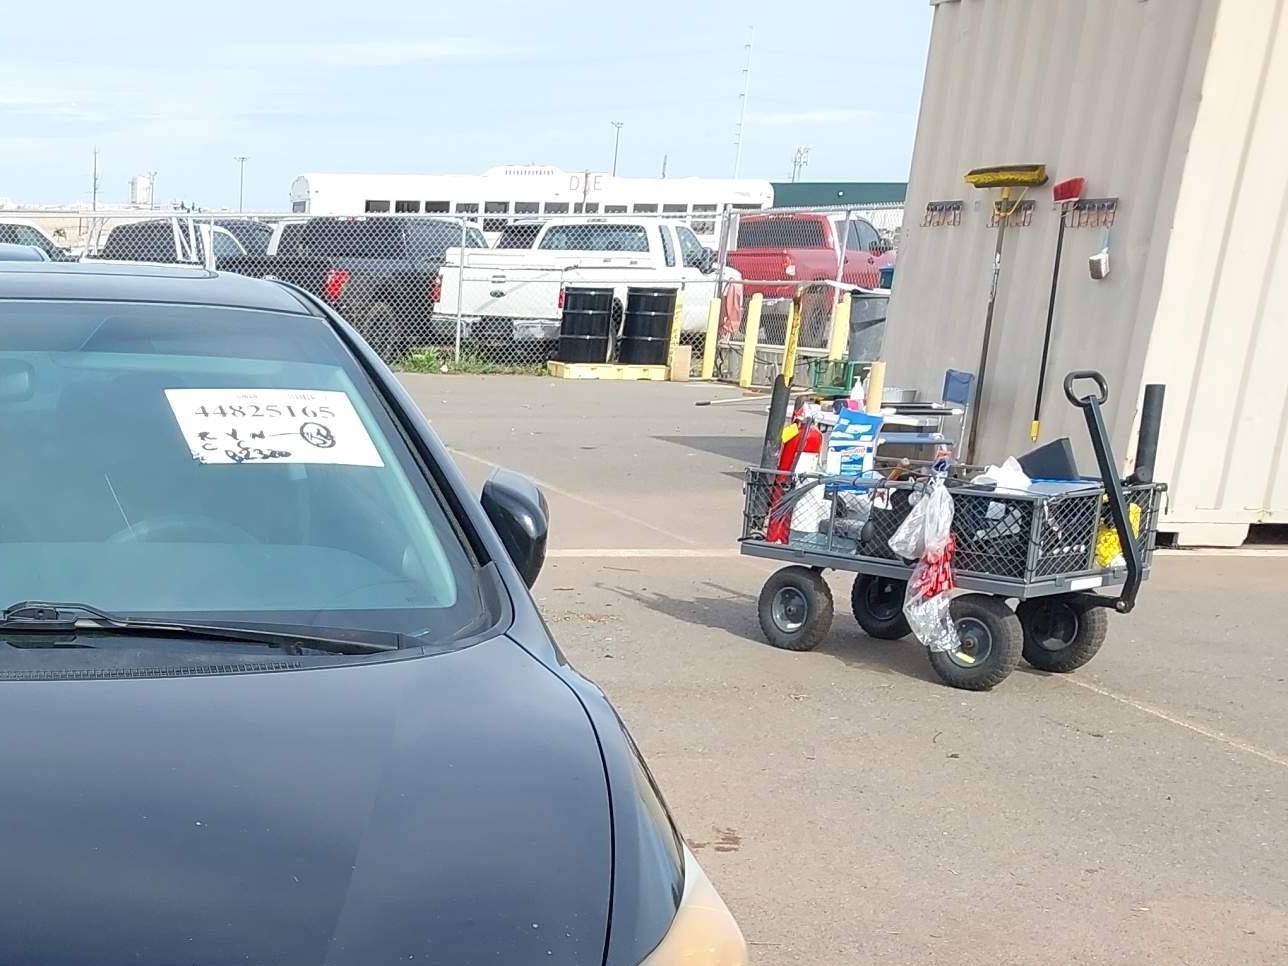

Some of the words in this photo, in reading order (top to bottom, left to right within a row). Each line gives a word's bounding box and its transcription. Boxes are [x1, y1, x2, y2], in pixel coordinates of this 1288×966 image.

[568, 175, 580, 191] D
[593, 175, 604, 191] E
[194, 404, 336, 419] 44825165
